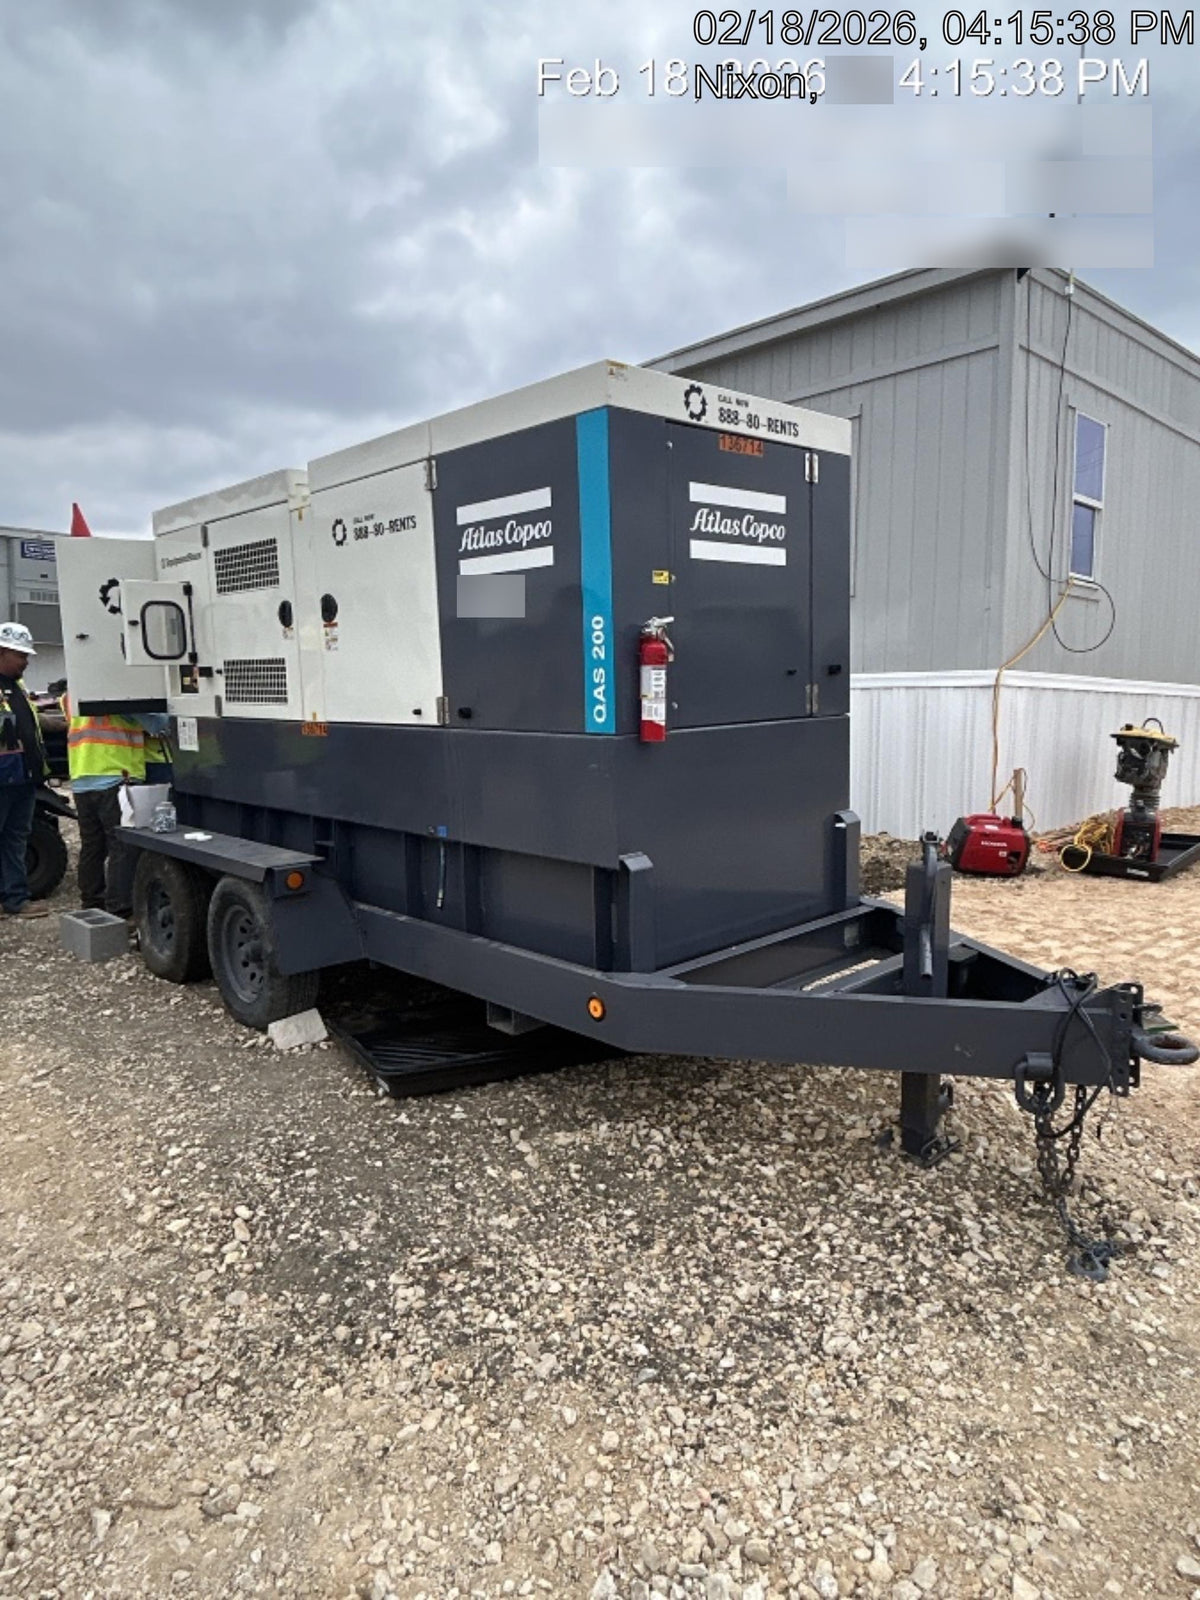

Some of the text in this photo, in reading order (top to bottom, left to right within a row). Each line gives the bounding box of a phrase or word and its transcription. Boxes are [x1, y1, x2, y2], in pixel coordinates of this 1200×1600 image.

[718, 406, 799, 438] 888-80-RENTS
[591, 615, 606, 724] QAS 200
